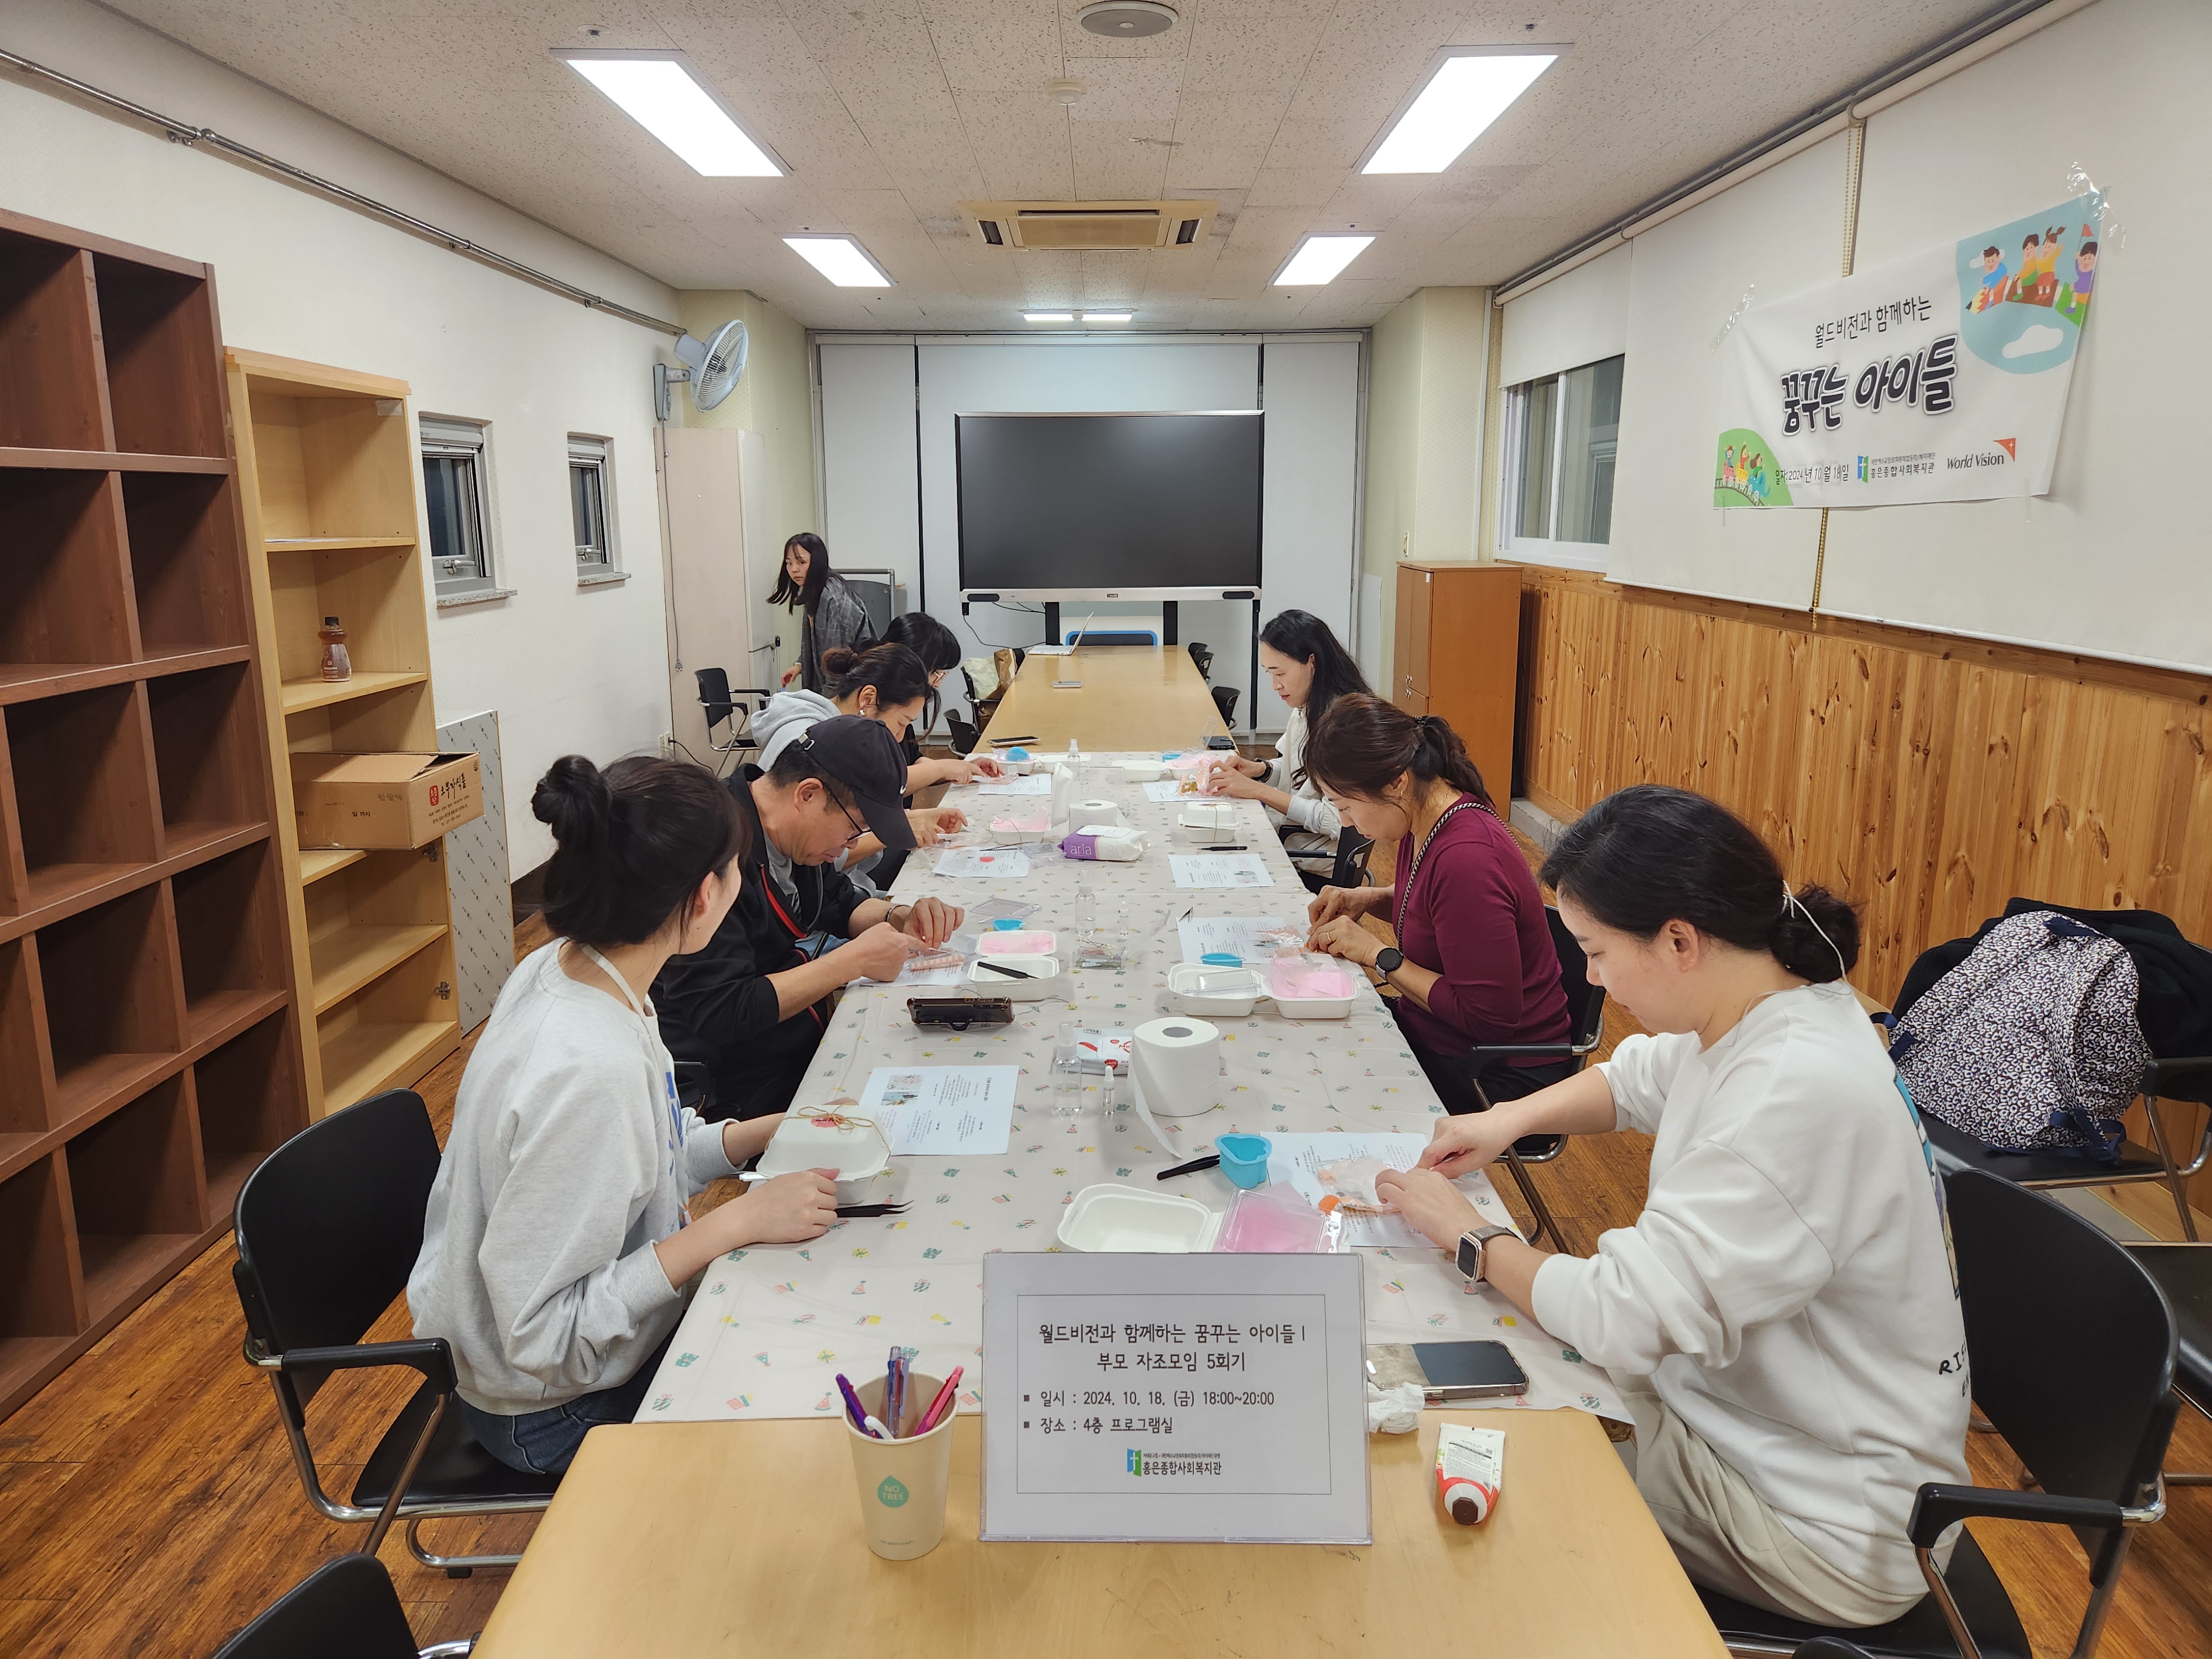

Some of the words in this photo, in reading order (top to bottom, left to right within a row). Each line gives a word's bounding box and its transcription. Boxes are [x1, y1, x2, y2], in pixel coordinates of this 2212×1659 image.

[1815, 310, 1872, 349] 월드비전과
[1876, 295, 1932, 333] 함께하는
[1854, 335, 1958, 415] 아이들
[1947, 453, 1973, 469] World
[1975, 452, 2005, 467] Vision
[1107, 844, 1124, 858] 80
[1039, 1323, 1117, 1344] 월드비전과
[1124, 1323, 1186, 1343] 함께하는
[1194, 1324, 1241, 1343] 꿈꾸는
[1097, 1353, 1128, 1371] 부모
[1136, 1352, 1197, 1372] 자조모임
[1207, 1352, 1245, 1371] 5회기
[1041, 1390, 1065, 1407] 일시
[1083, 1391, 1115, 1406] 2024.
[1123, 1391, 1140, 1406] 10.
[1149, 1391, 1165, 1406] 18.
[1174, 1390, 1194, 1407] (금)
[1203, 1391, 1274, 1405] 18:00~20:00
[1040, 1417, 1066, 1434] 장소
[1083, 1417, 1103, 1434] 4층
[1110, 1417, 1172, 1434] 프로그램실
[1142, 1461, 1222, 1475] 홍은종합사회복지관
[884, 1485, 900, 1493] NO
